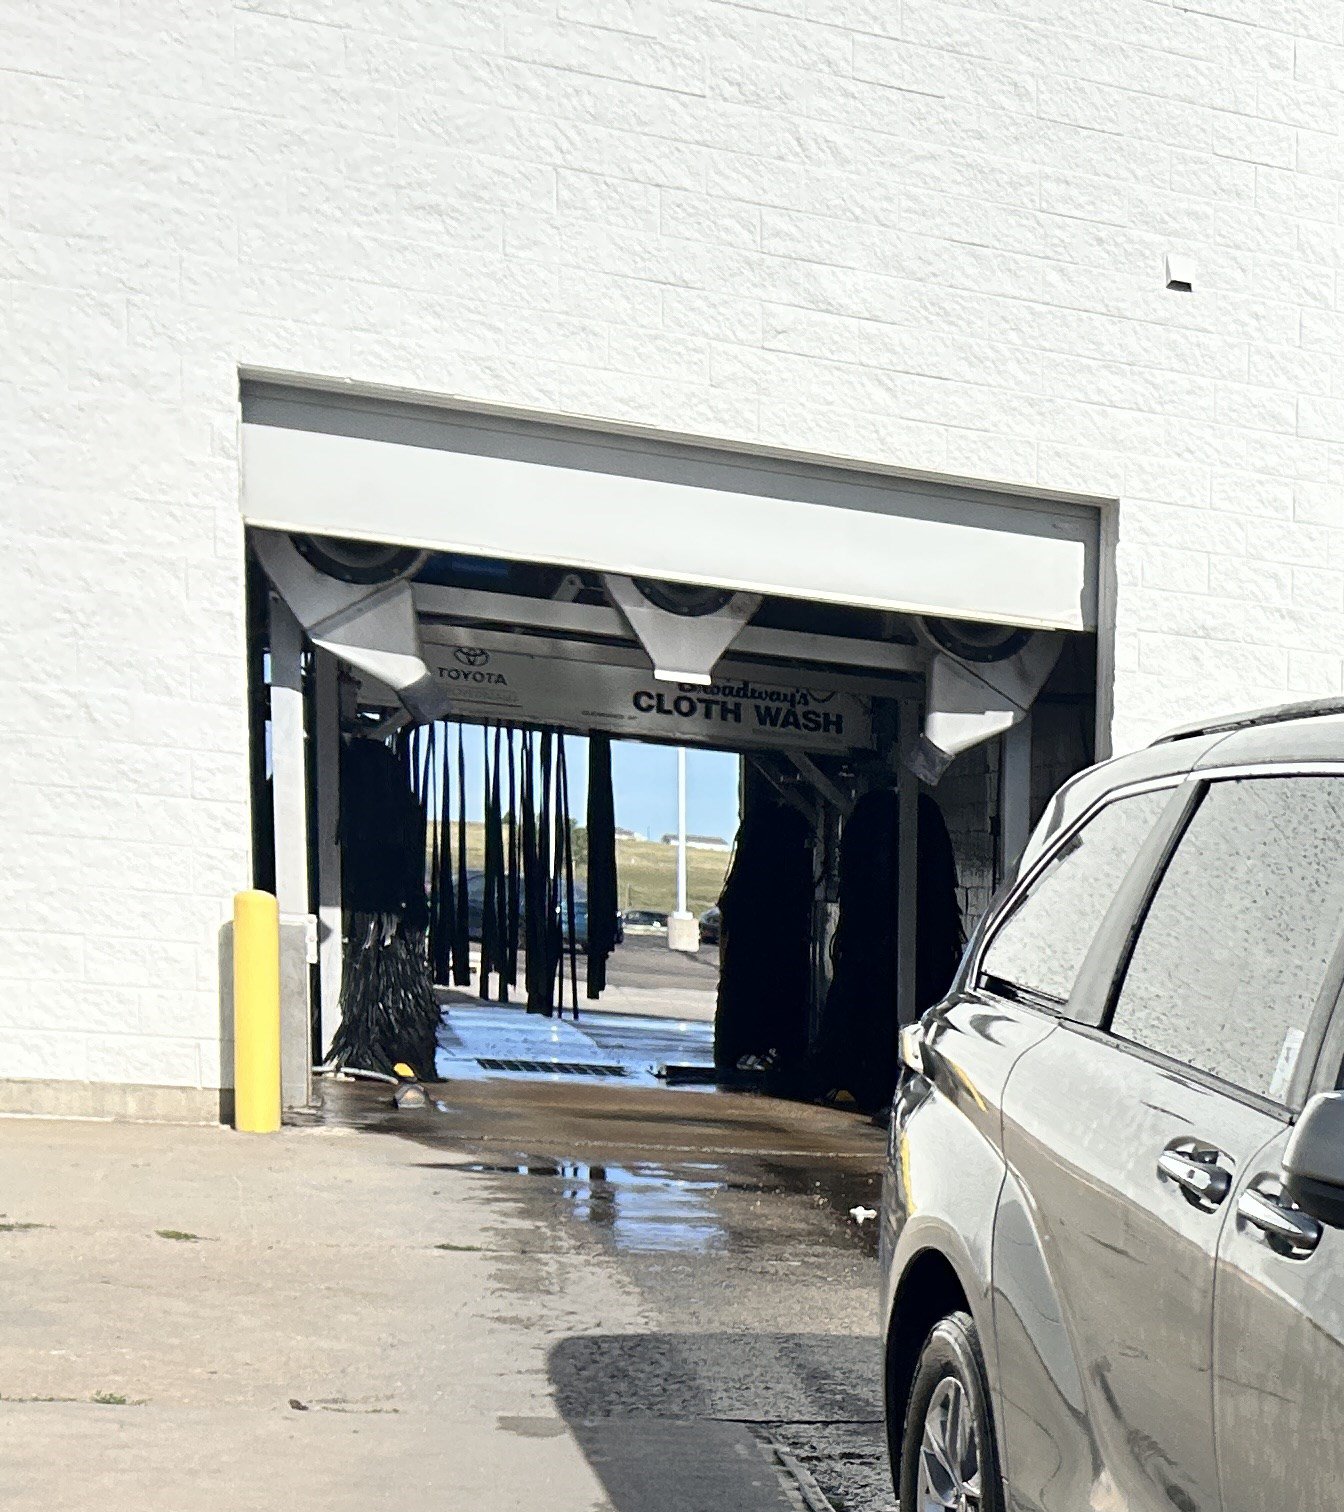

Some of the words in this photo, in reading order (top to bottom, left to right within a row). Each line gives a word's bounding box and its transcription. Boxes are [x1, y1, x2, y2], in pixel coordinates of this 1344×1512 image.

[437, 667, 508, 686] TOYOTA
[632, 690, 742, 723] CLOTH
[753, 704, 844, 734] WASH
